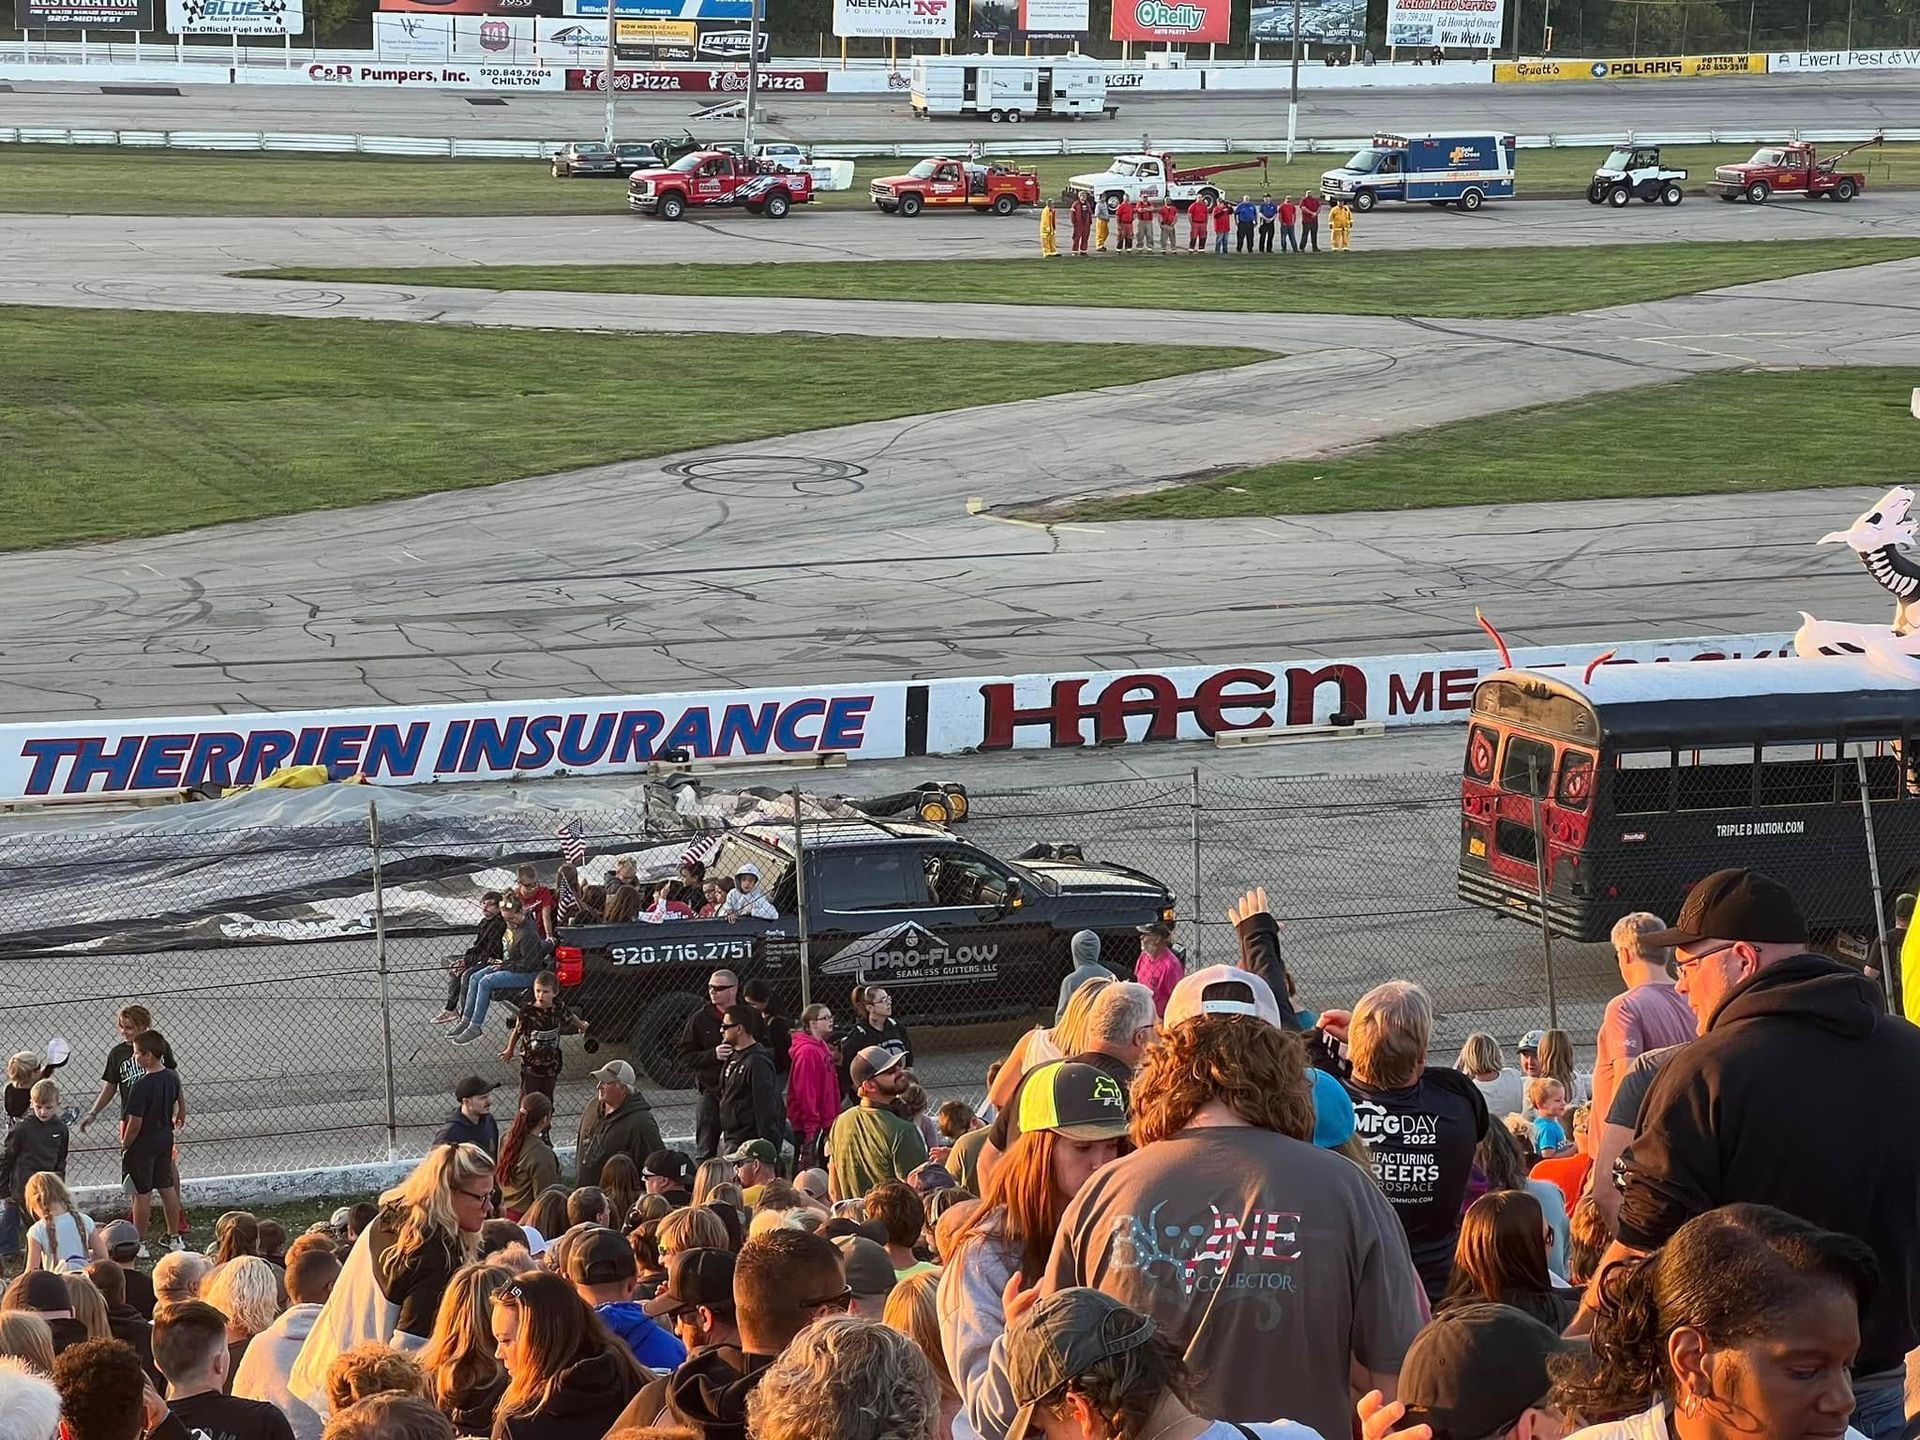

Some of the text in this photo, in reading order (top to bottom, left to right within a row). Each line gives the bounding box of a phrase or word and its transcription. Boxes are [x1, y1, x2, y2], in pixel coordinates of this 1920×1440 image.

[846, 0, 911, 9] NEENAH
[1396, 0, 1497, 11] Action Auto Service
[47, 15, 123, 23] 920-MIDWEST
[1137, 2, 1204, 29] O'Reilly
[1437, 17, 1447, 26] Ed
[1476, 20, 1501, 28] Owner
[1441, 31, 1496, 44] Win With Us
[1738, 55, 1749, 63] WI
[1800, 53, 1841, 67] Ewert
[1848, 52, 1883, 66] Pest
[308, 65, 471, 84] C&R Pumpers, Inc.
[480, 68, 552, 78] 920.849.7604
[1611, 61, 1683, 75] POLARIS
[491, 77, 541, 87] CHILTON
[631, 73, 681, 91] Pizza
[756, 73, 805, 91] Pizza
[20, 695, 875, 796] THERRIEN INSURANCE
[1716, 823, 1745, 837] TRIPLE
[1753, 821, 1805, 835] NATION.COM
[611, 940, 752, 966] 920.716.2751
[874, 944, 998, 970] PRO-FLOW
[896, 964, 998, 978] SEAMLESS GUTTERS LLC
[1403, 1134, 1437, 1145] 2022
